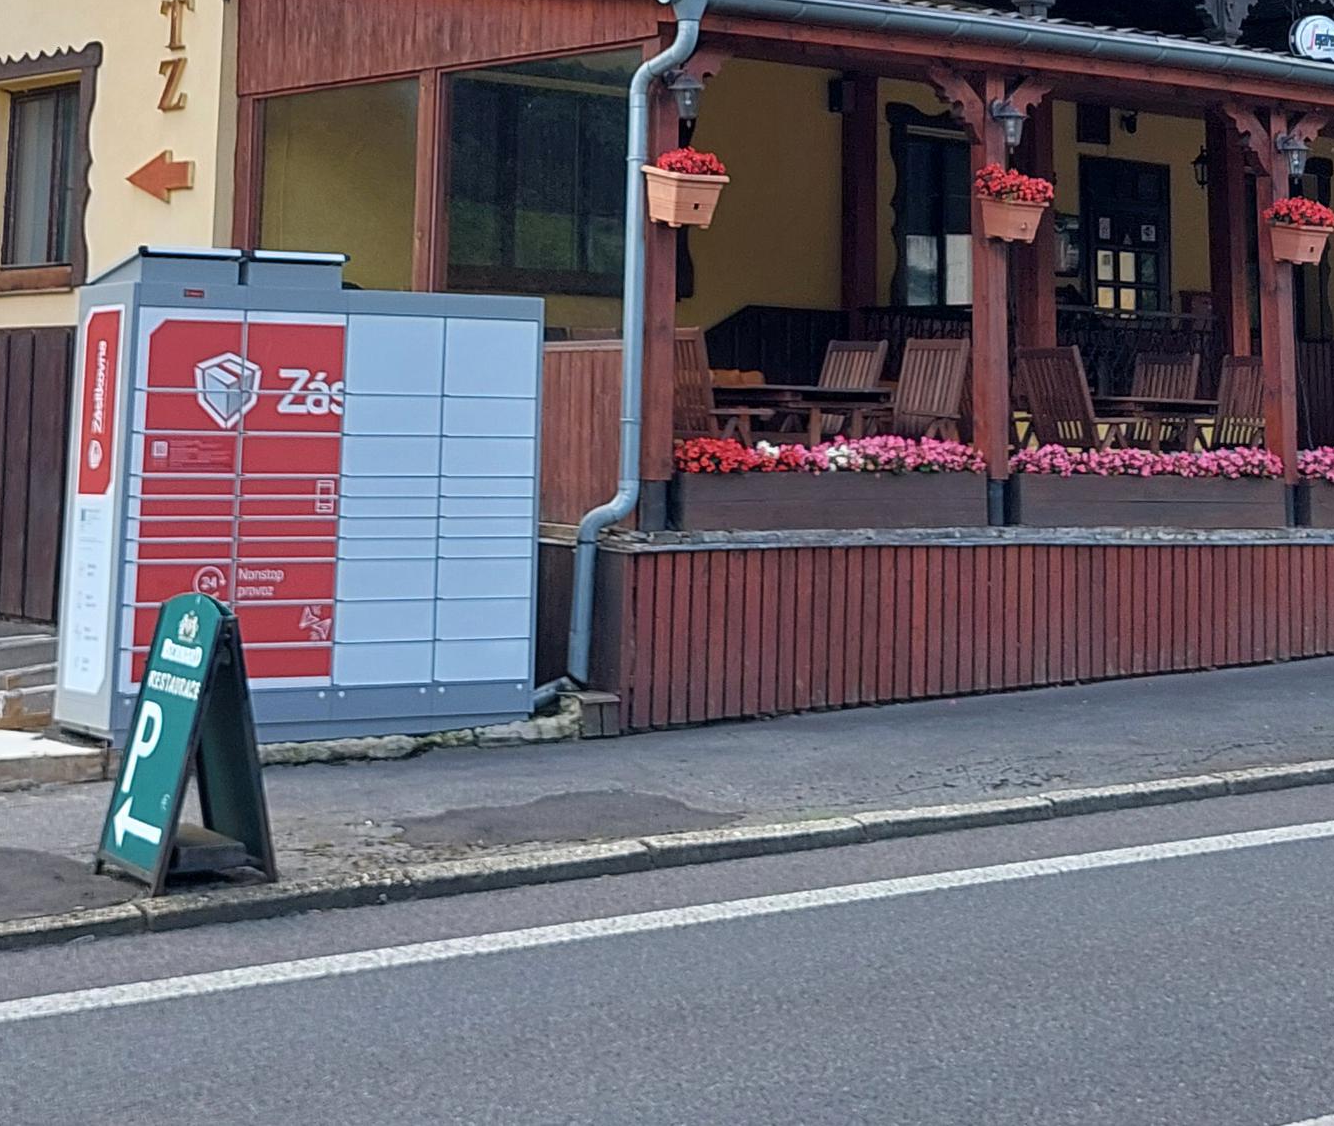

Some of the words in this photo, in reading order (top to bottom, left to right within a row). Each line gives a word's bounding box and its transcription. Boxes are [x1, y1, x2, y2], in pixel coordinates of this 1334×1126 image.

[237, 568, 284, 582] Nonstop
[236, 586, 274, 597] provoz
[121, 700, 163, 793] P
